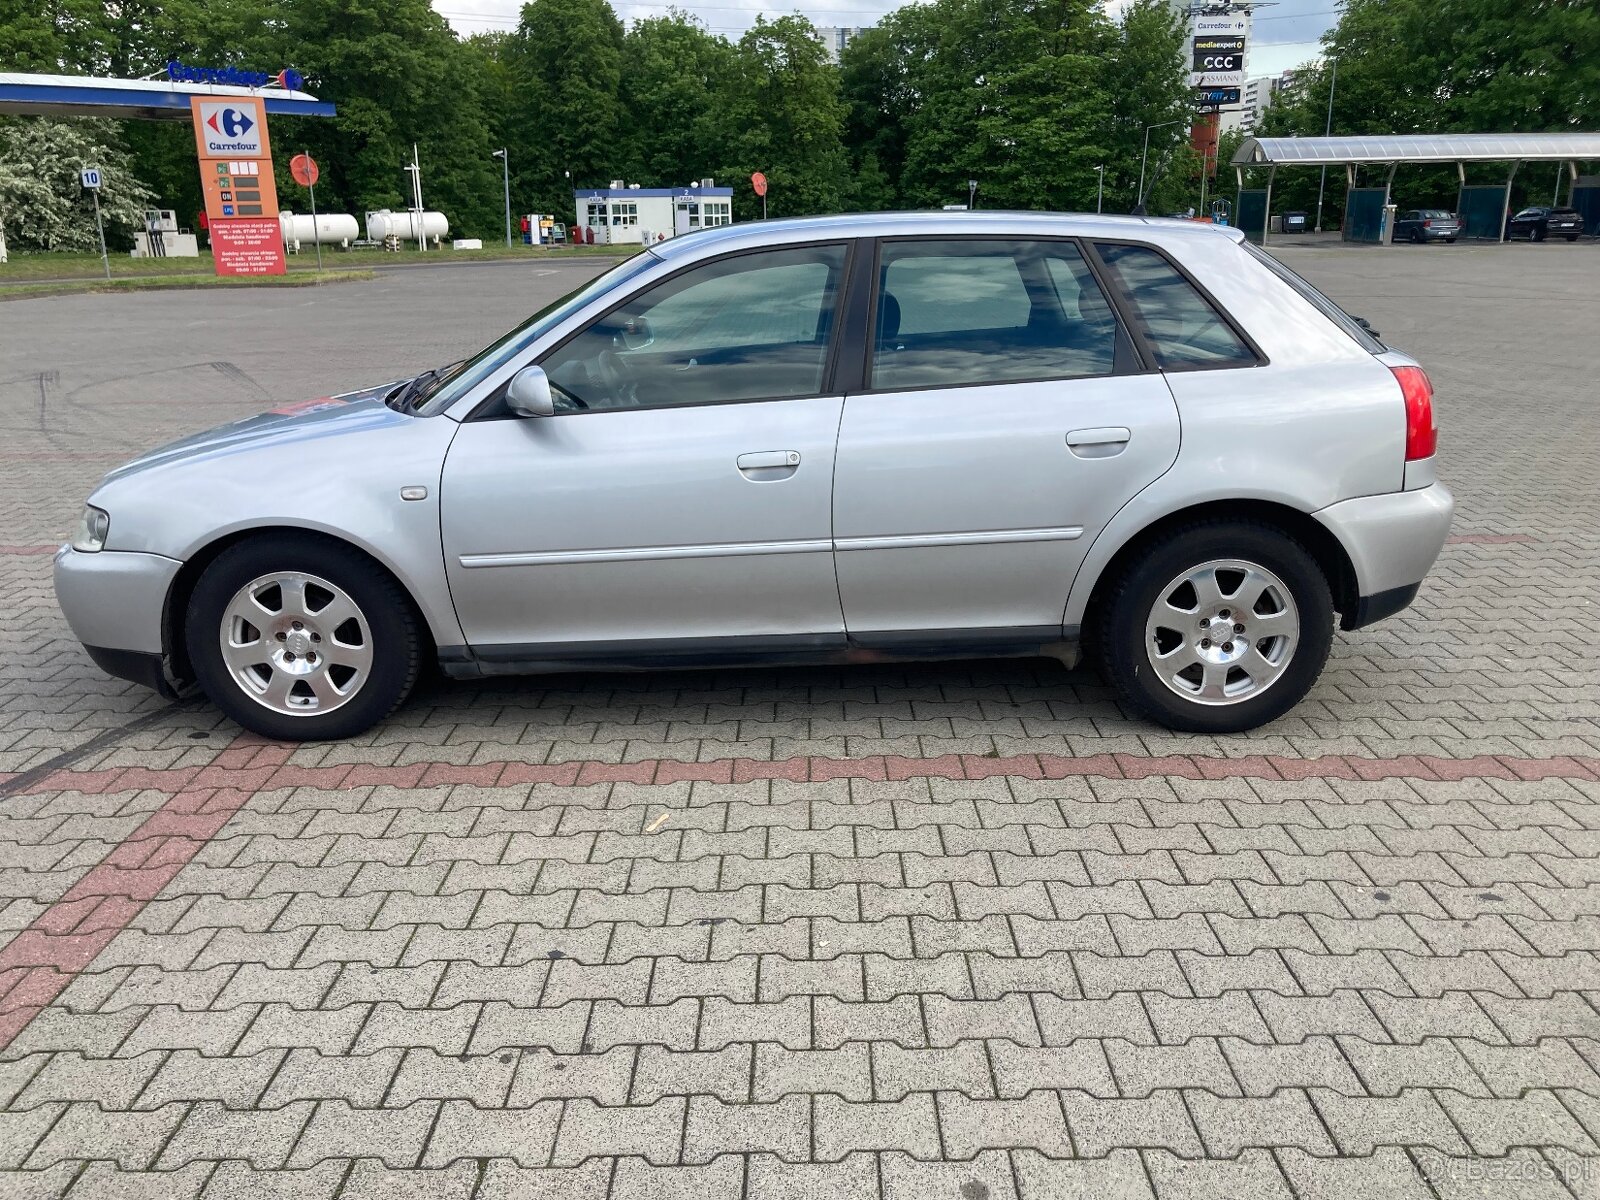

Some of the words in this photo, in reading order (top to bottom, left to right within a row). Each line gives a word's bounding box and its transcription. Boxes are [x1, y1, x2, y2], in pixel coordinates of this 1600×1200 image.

[1195, 41, 1236, 49] mediaexpert
[1203, 56, 1234, 69] CCC
[209, 141, 258, 151] Carrefour
[84, 171, 98, 185] 10
